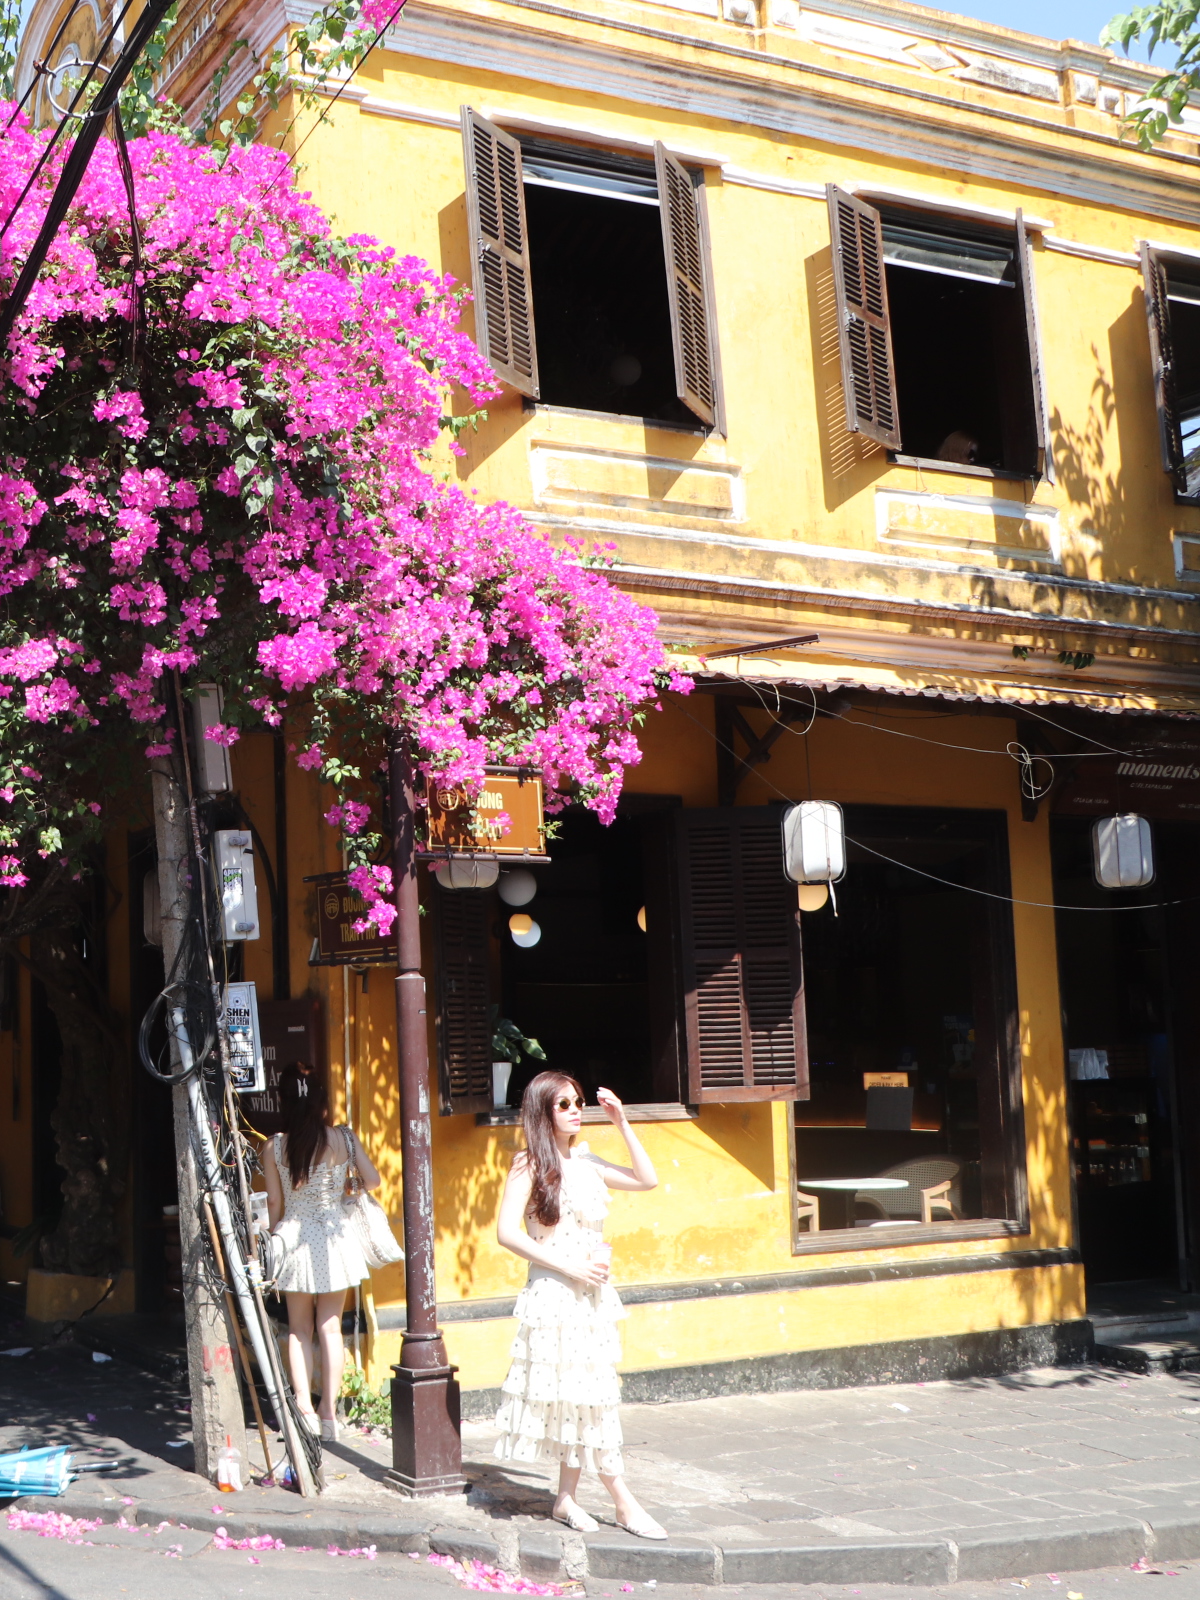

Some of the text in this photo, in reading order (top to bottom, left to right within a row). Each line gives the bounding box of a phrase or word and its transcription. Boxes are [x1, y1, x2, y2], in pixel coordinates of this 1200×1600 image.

[1116, 761, 1200, 779] moments
[226, 1007, 250, 1017] SHEN
[251, 1091, 275, 1113] with
